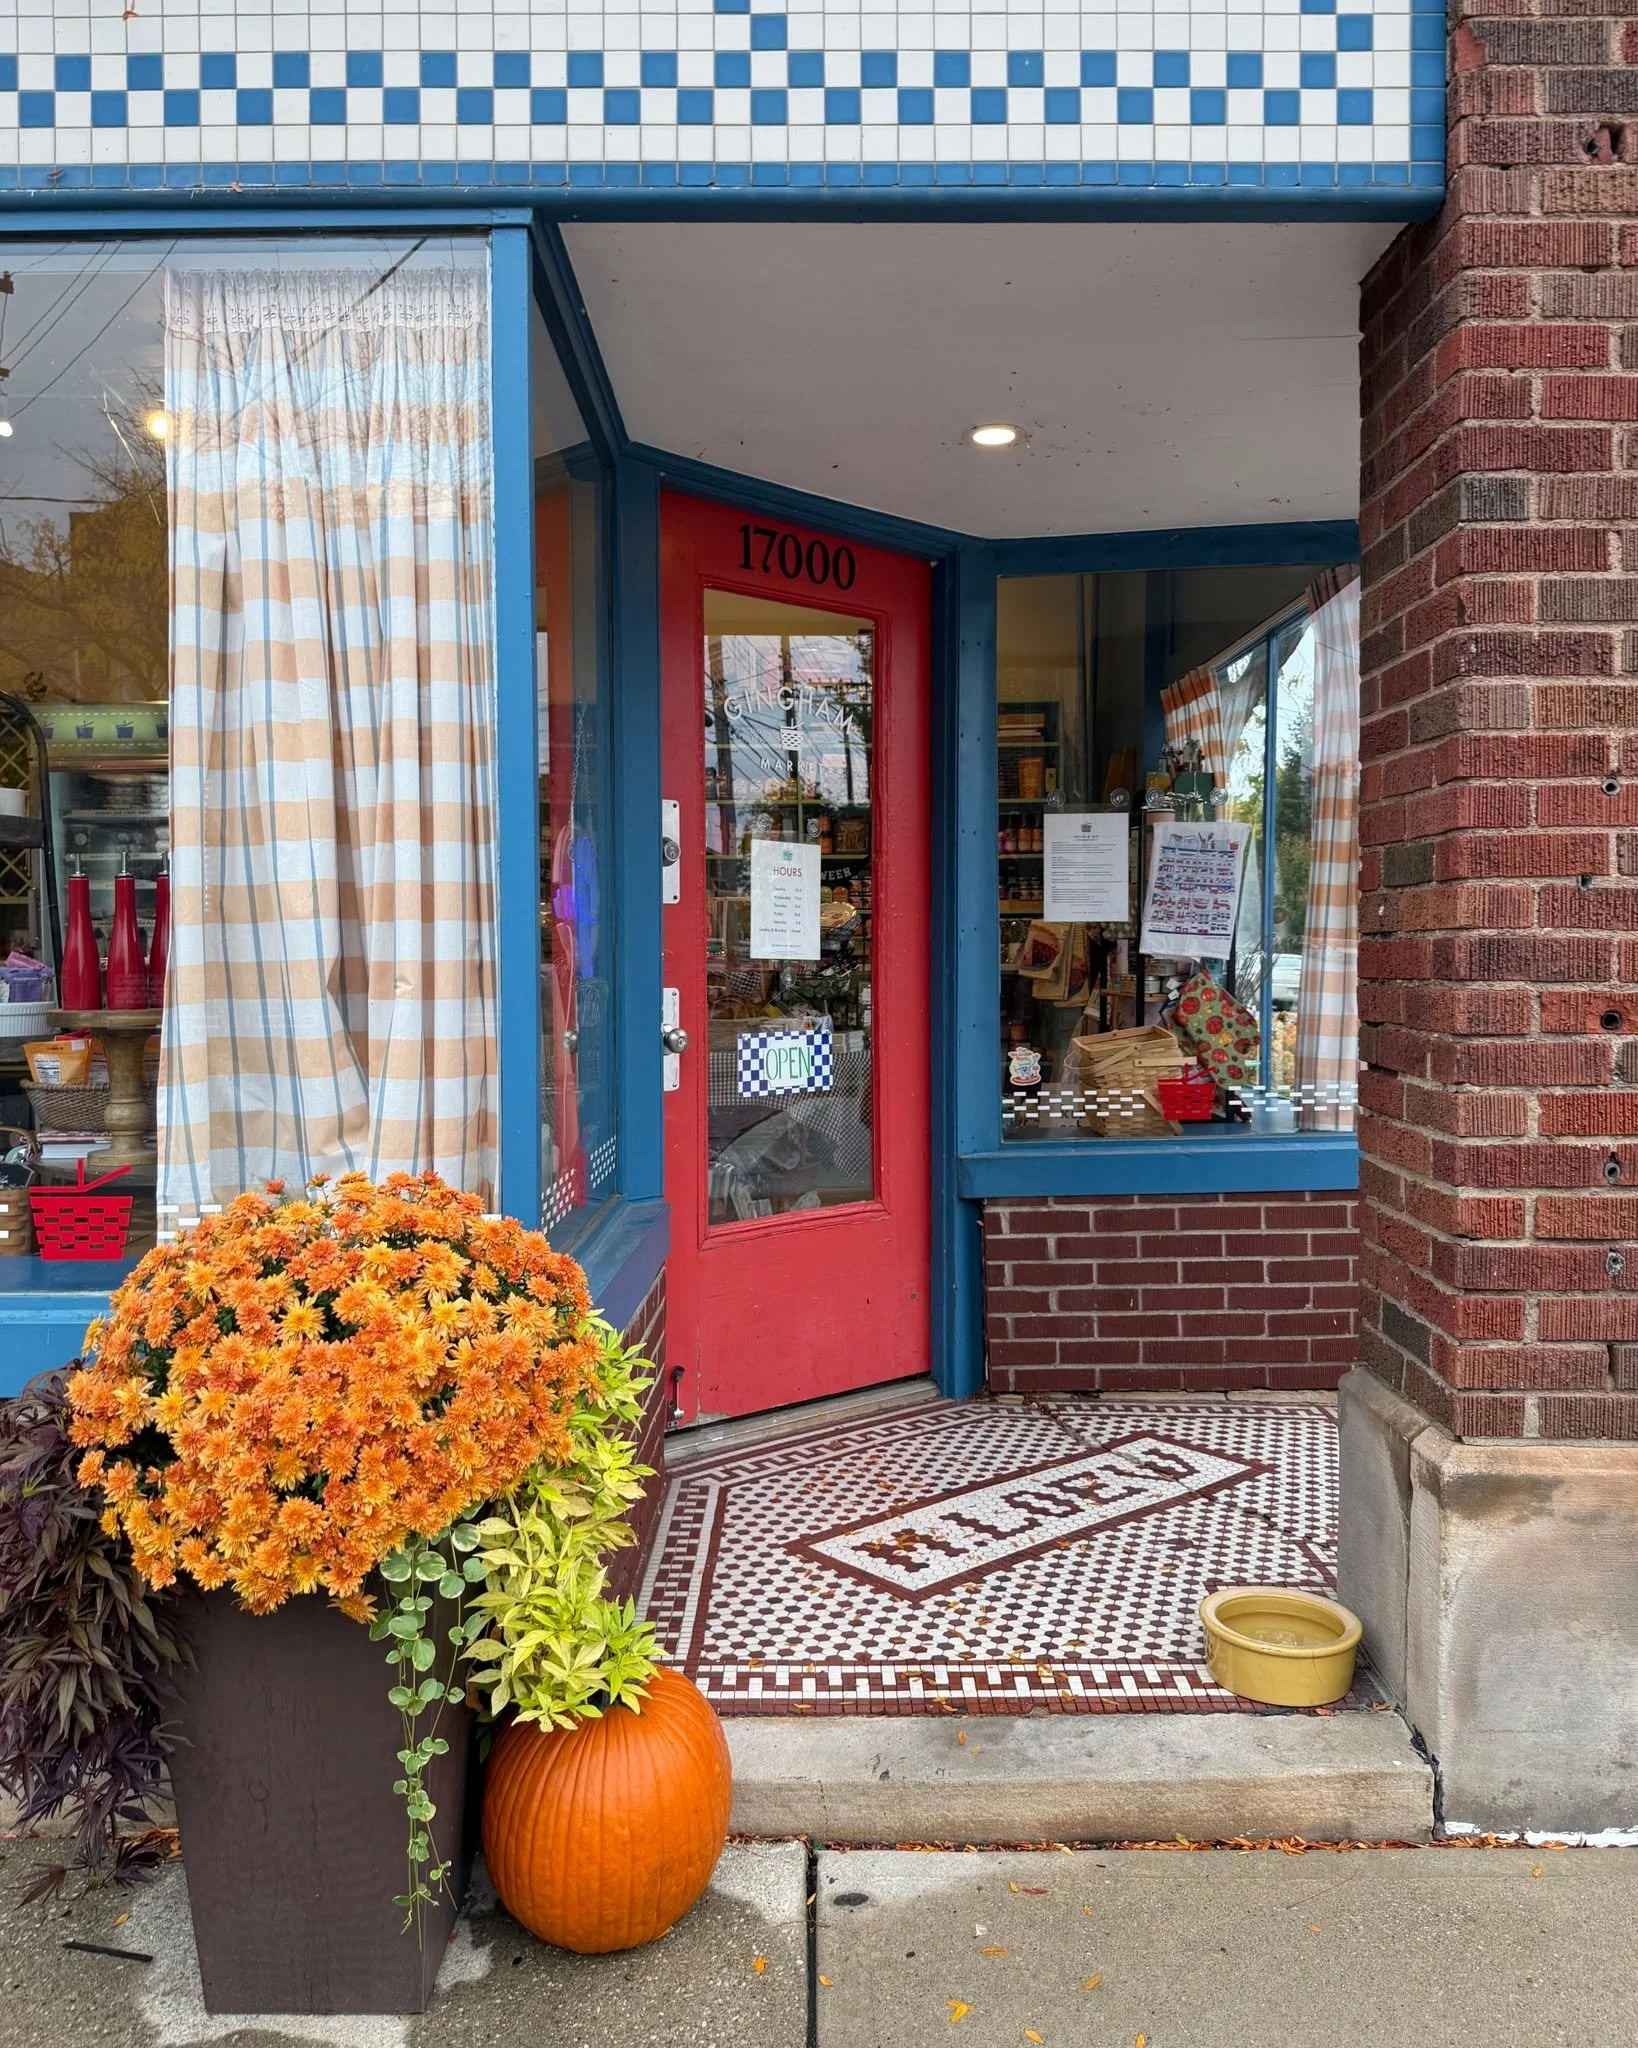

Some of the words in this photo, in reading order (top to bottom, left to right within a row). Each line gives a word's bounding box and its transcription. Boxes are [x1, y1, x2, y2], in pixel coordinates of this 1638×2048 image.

[738, 523, 856, 590] 17000
[723, 686, 855, 735] GINGHAM
[760, 758, 824, 773] MARKET
[773, 866, 803, 878] HOURS
[765, 1046, 811, 1081] OPEN
